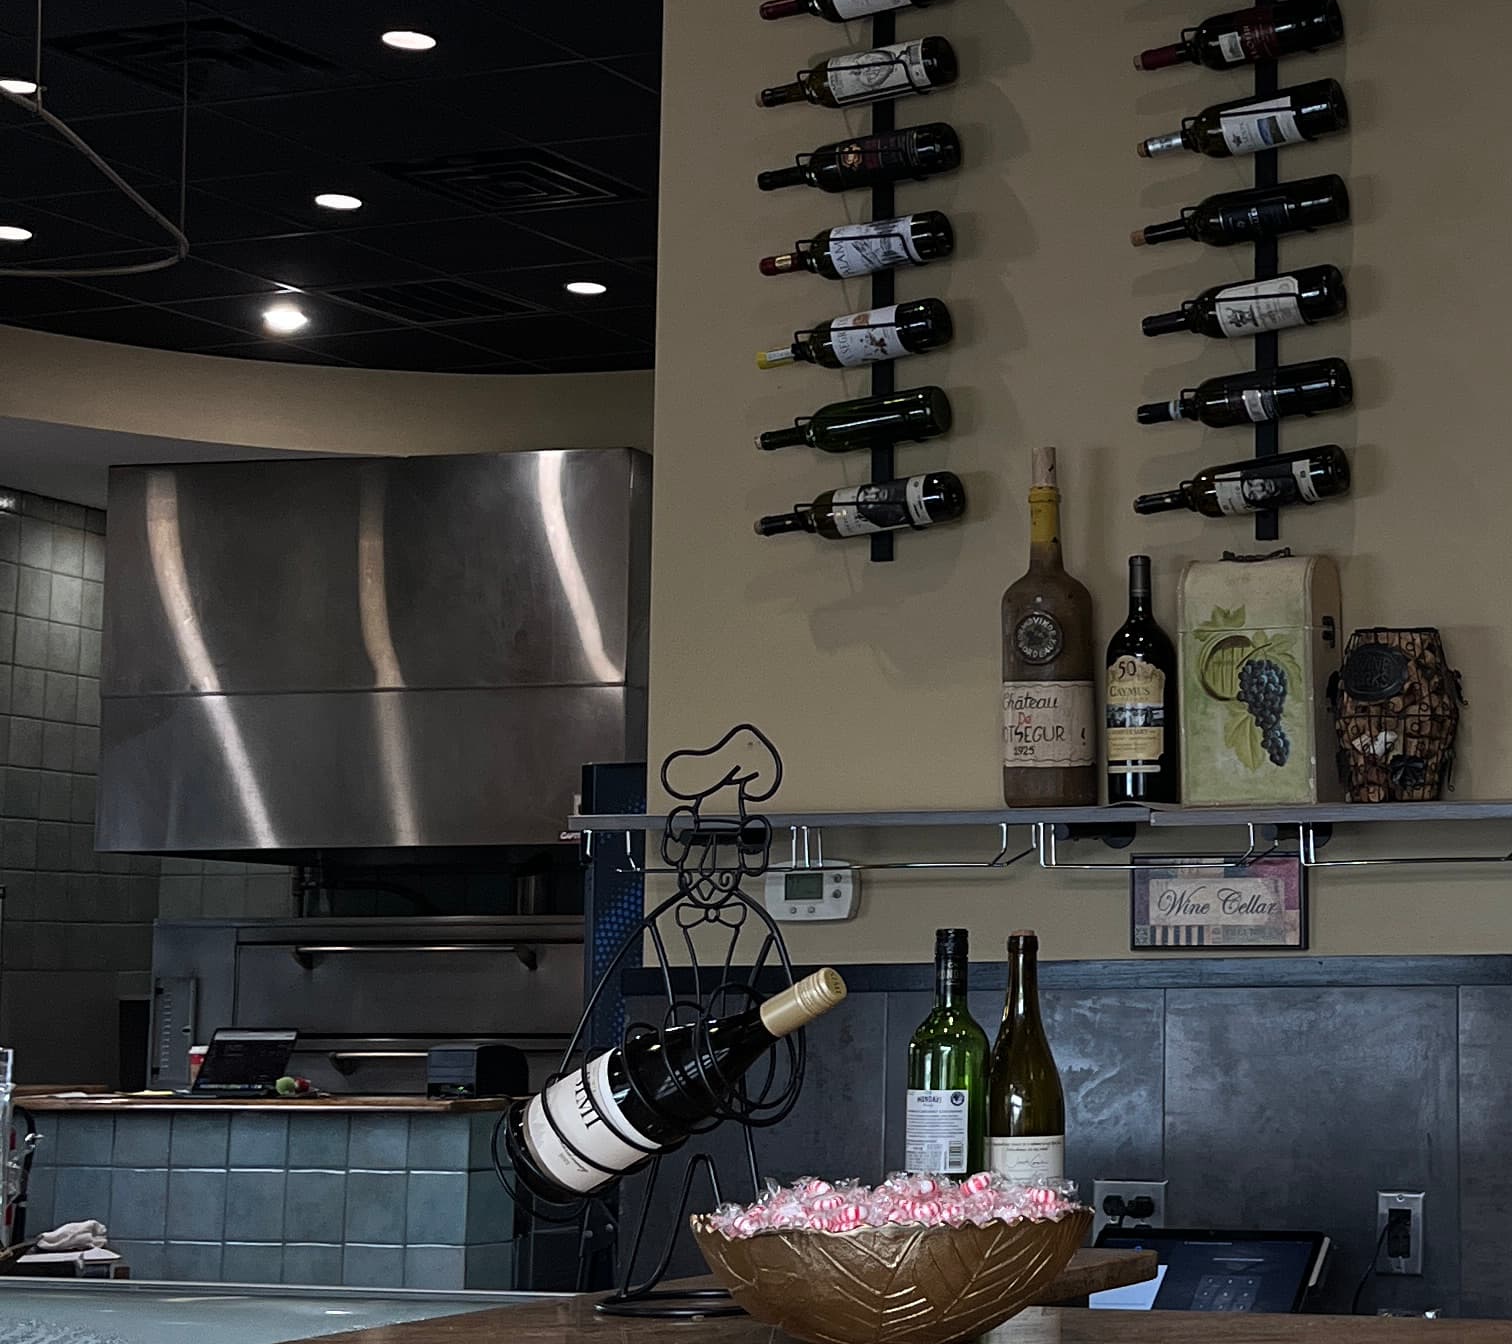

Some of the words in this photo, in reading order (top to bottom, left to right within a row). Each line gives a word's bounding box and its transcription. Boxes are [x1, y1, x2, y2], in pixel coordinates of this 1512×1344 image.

[1118, 660, 1137, 680] 50
[1158, 886, 1210, 916] Wine
[1217, 887, 1278, 915] Cellar
